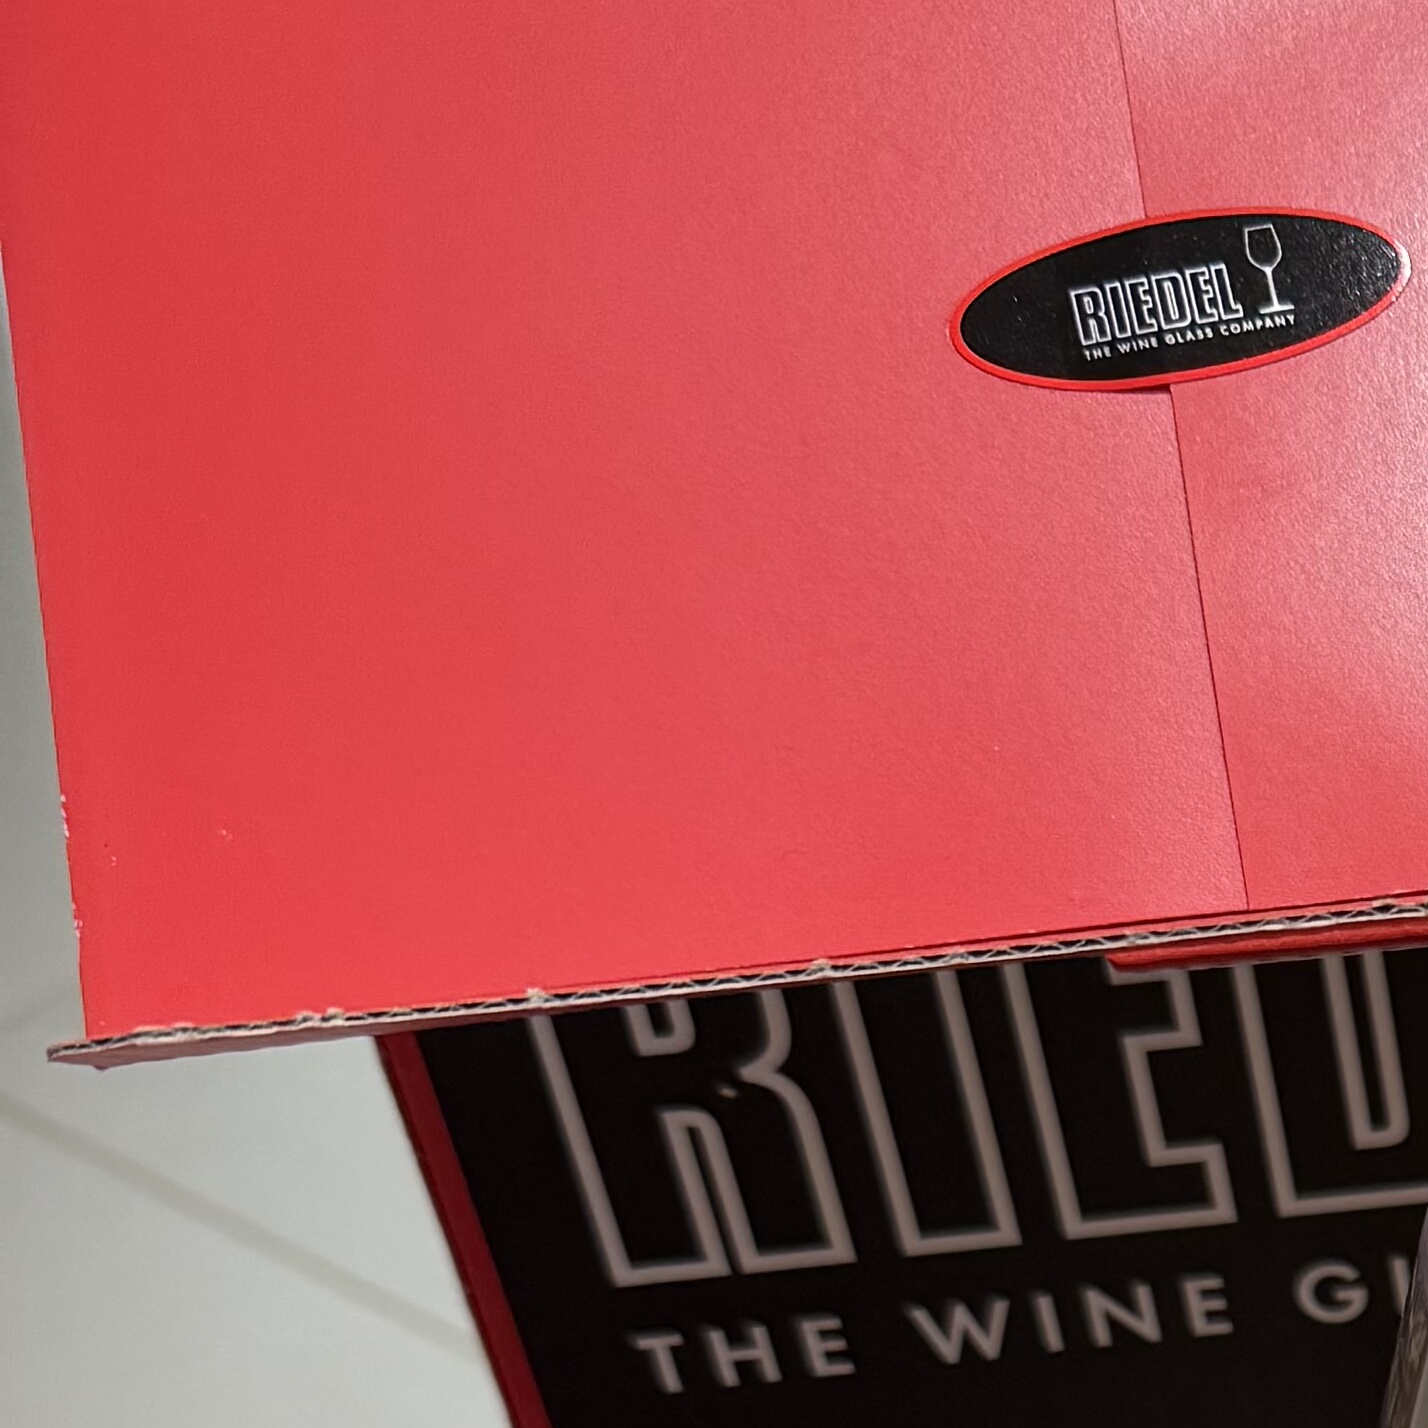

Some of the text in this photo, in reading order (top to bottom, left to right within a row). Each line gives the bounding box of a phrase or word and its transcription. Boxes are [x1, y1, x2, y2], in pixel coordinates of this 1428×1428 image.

[1069, 261, 1243, 346] RIEDEL
[1082, 314, 1297, 362] THE WINE GLASS COMPANY
[627, 1313, 857, 1395] THE
[904, 1271, 1235, 1366] WINE
